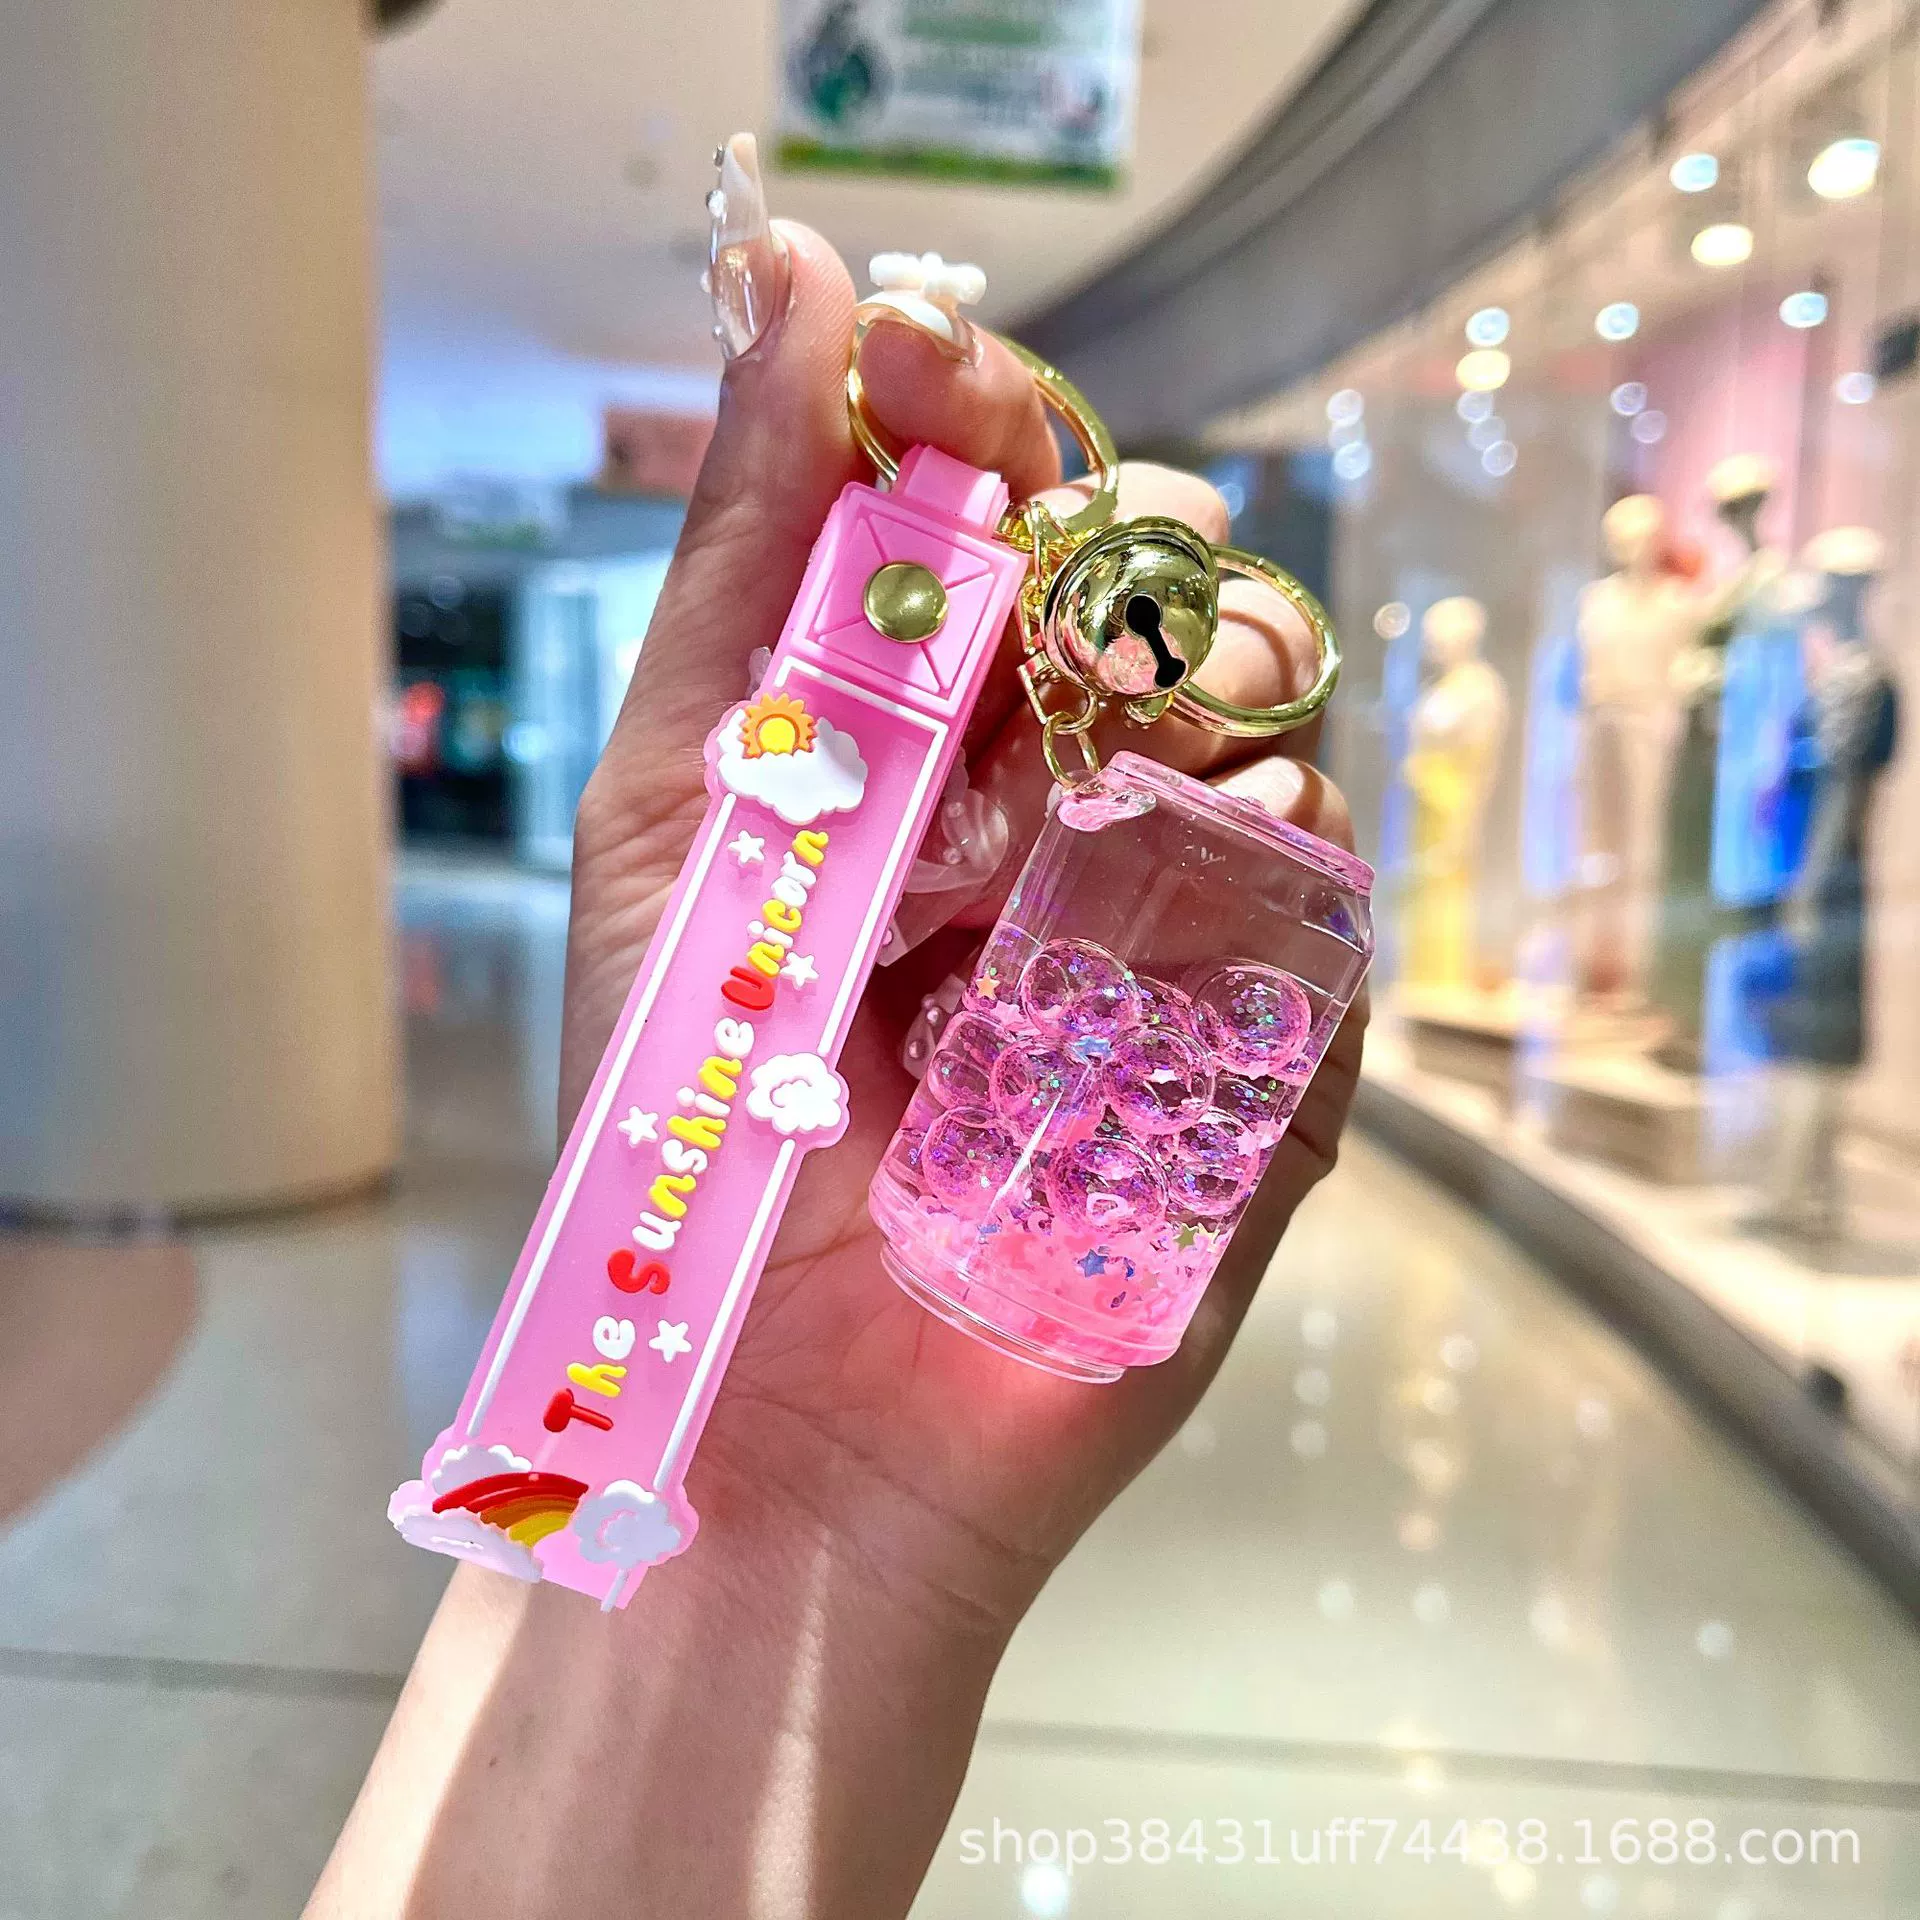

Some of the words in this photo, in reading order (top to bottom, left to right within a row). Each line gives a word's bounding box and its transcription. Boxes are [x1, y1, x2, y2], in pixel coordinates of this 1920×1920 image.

[543, 1315, 636, 1432] The
[608, 1017, 755, 1295] Sunshine
[721, 830, 829, 1011] Unicorn
